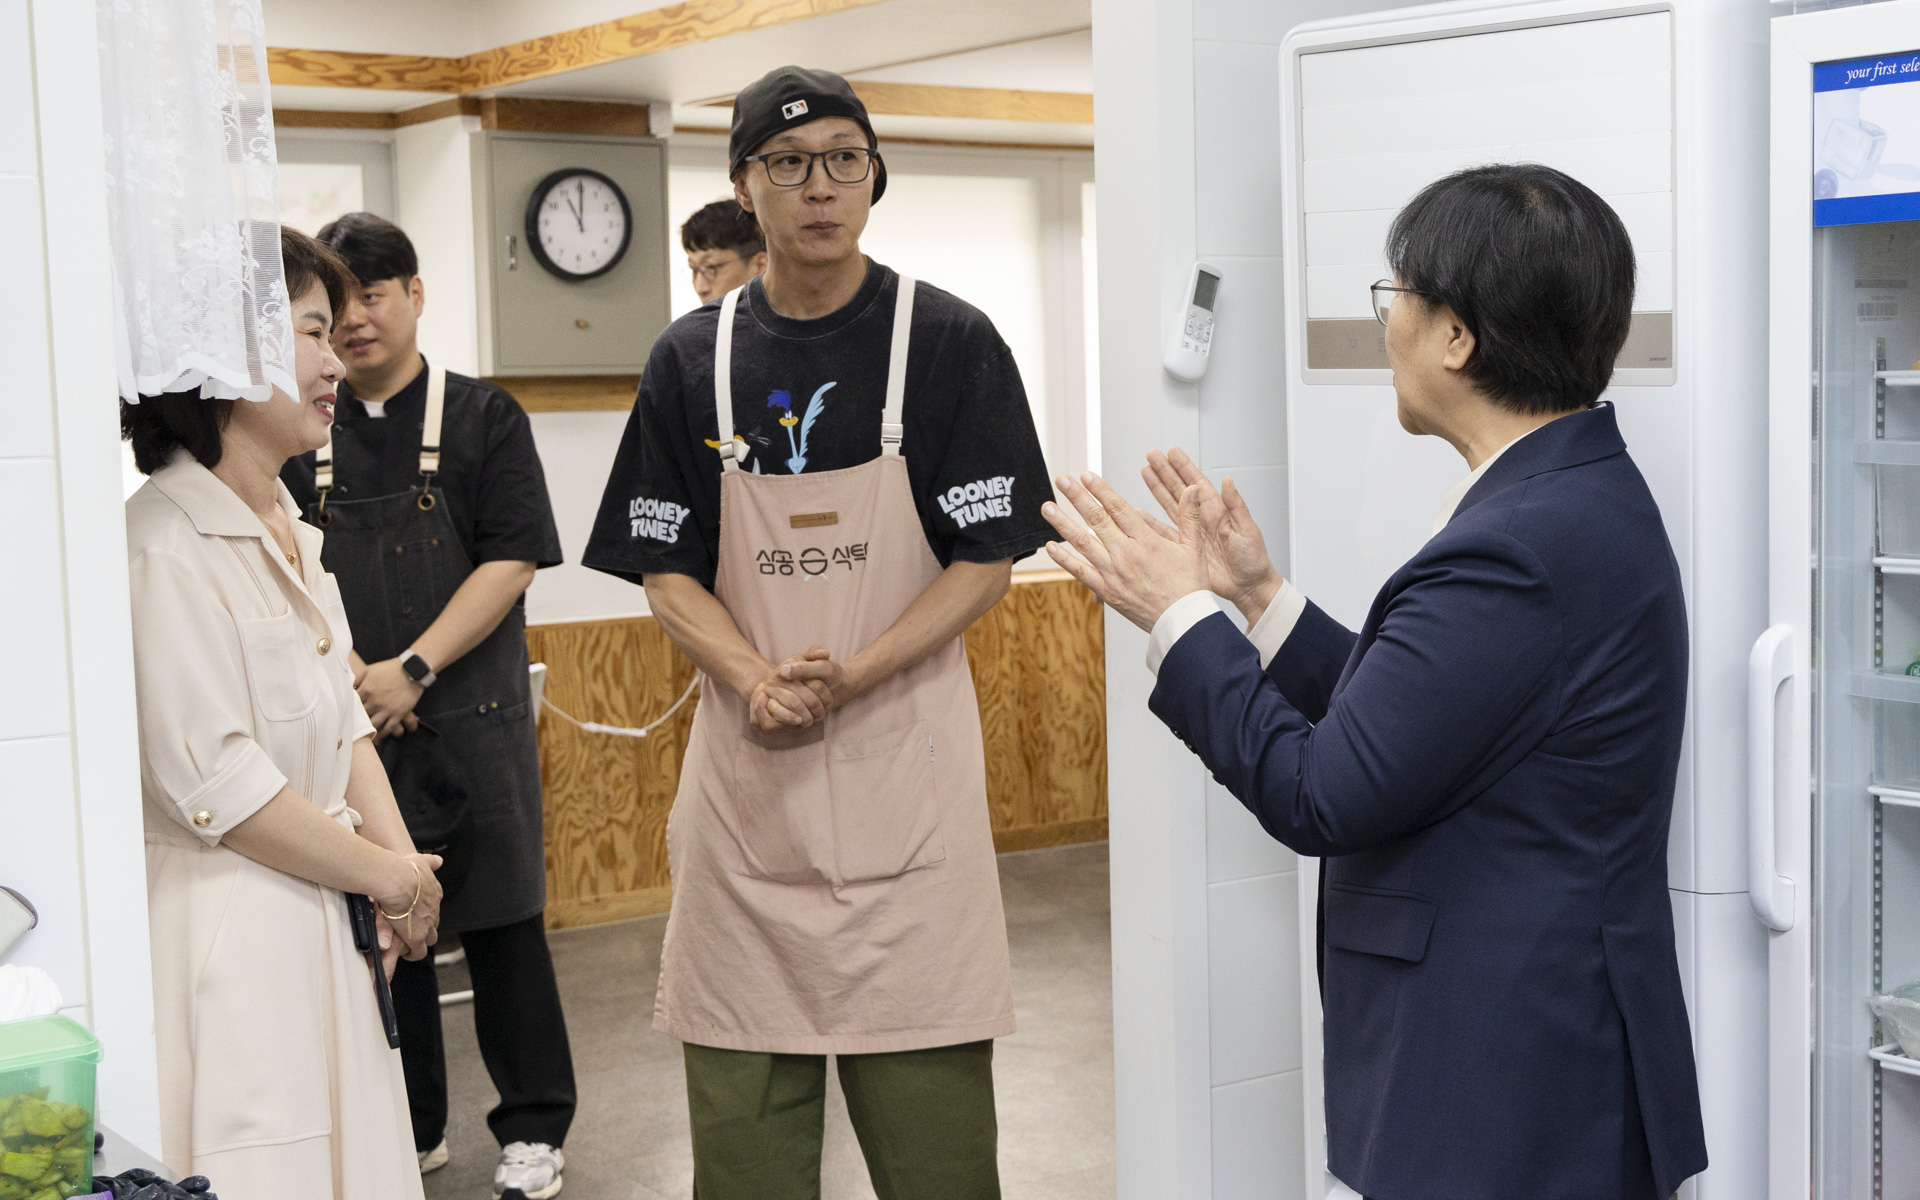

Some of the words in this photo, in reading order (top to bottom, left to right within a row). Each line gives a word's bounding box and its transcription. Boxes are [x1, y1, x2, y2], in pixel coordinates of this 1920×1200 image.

[1845, 67, 1872, 84] your
[1870, 61, 1897, 81] first
[937, 476, 1015, 514] LOONEY
[629, 496, 691, 525] LOONEY
[950, 496, 1012, 529] TUNES
[631, 517, 680, 543] TUNES
